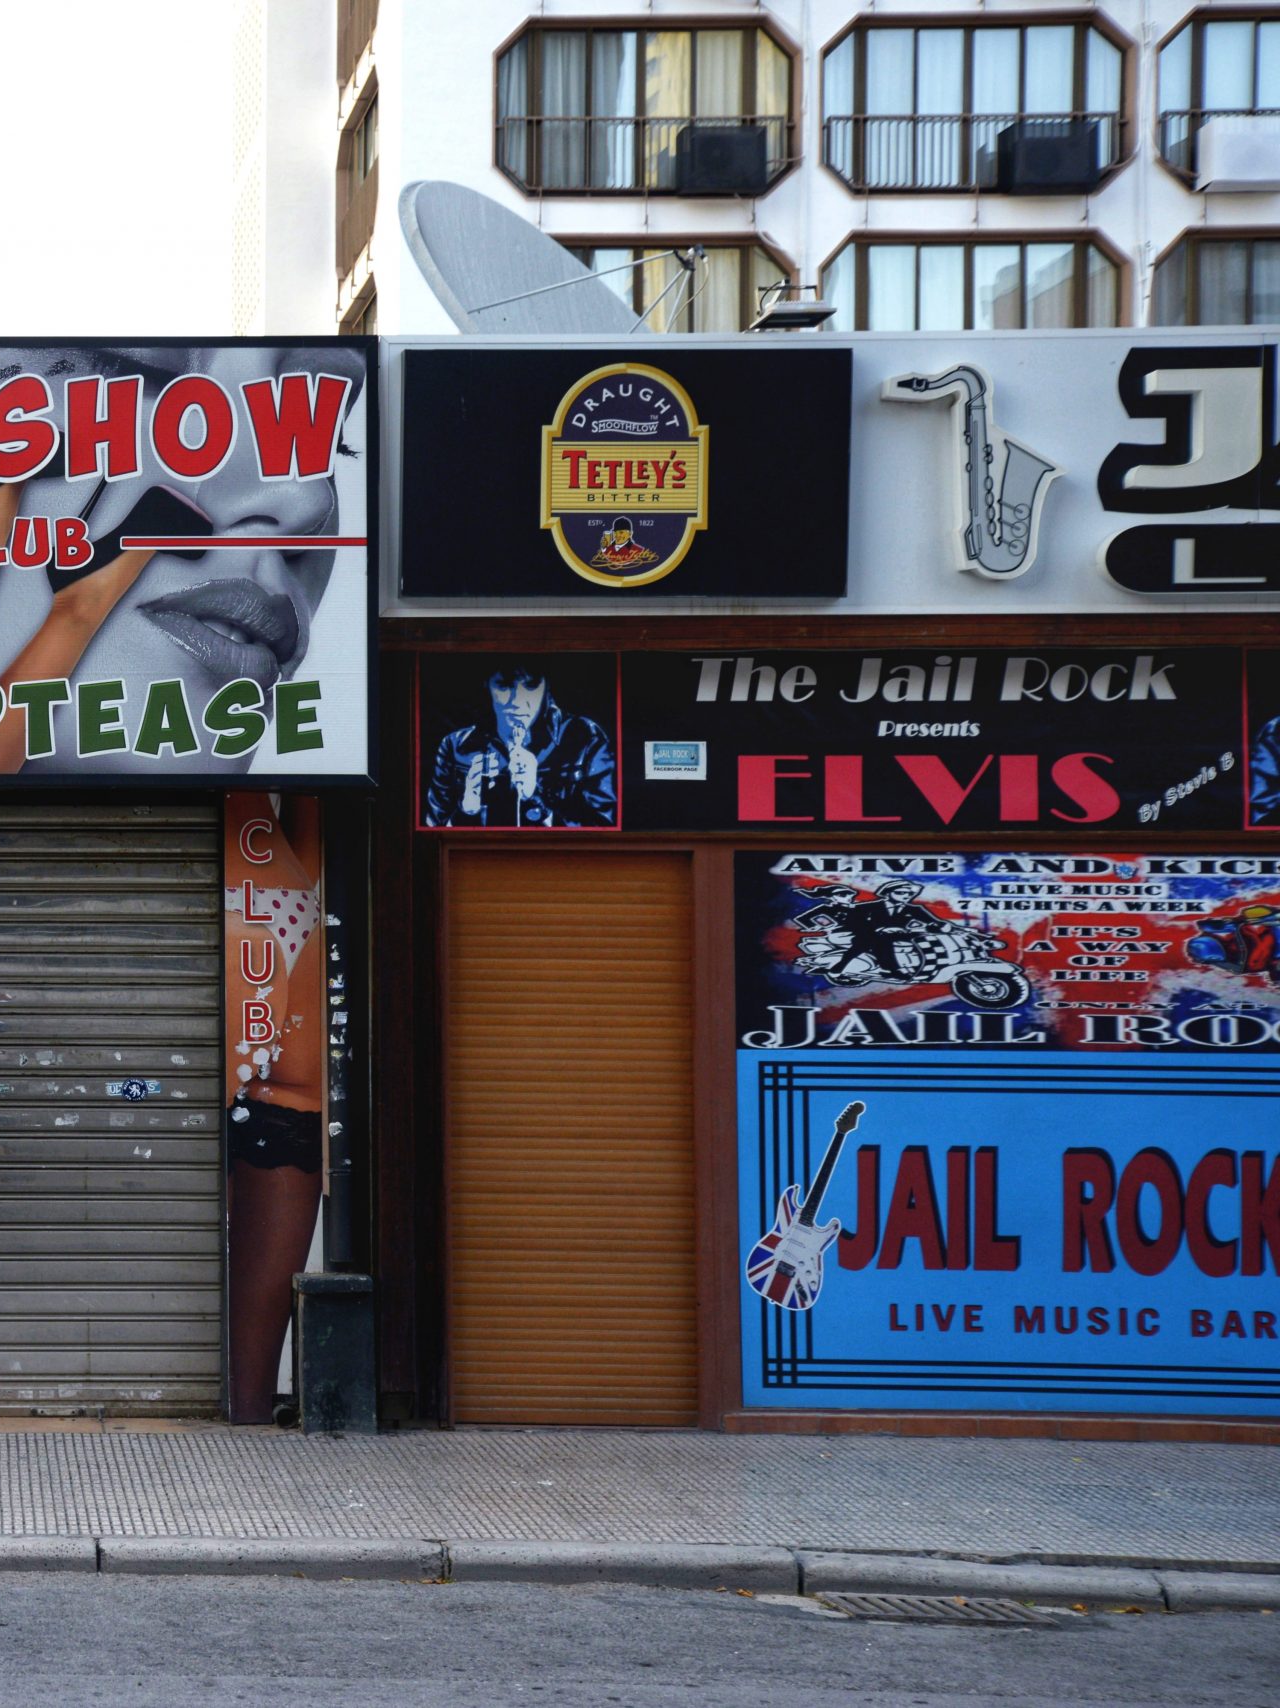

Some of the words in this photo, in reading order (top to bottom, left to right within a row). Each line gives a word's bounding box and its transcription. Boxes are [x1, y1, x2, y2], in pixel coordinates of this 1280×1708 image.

[572, 383, 679, 428] DRAUGHT
[591, 419, 659, 435] SMOOTHFLOW
[562, 450, 686, 489] TETLEY'S
[587, 493, 660, 502] BITTER
[691, 656, 818, 703] The
[839, 655, 976, 703] Jail
[999, 655, 1178, 702] Rock
[877, 719, 981, 738] Presents
[738, 753, 1121, 825] ELVIS
[1138, 800, 1161, 823] By
[1164, 766, 1217, 807] Stevie
[1219, 751, 1235, 771] B
[780, 857, 956, 874] ALIVE
[987, 858, 1111, 874] AND
[1000, 884, 1062, 895] LIVE
[1071, 885, 1162, 896] MUSIC
[958, 901, 971, 911] 7
[982, 901, 1088, 911] NIGHTS
[1096, 902, 1115, 911] A
[1121, 902, 1206, 912] WEEK
[238, 818, 276, 1047] CLUB
[1053, 927, 1140, 938] IT'S
[1026, 941, 1057, 952] A
[1079, 941, 1172, 953] WAY
[1070, 956, 1128, 967] OF
[1052, 971, 1148, 982] LIFE
[1034, 1001, 1180, 1011] ONLY
[741, 1005, 1046, 1049] JAIL
[1077, 1014, 1280, 1047] RO
[837, 1144, 1022, 1272] JAIL
[1061, 1145, 1280, 1278] ROCK
[888, 1303, 985, 1332] LIVE
[1014, 1305, 1162, 1336] MUSIC
[1191, 1309, 1279, 1340] BAR
